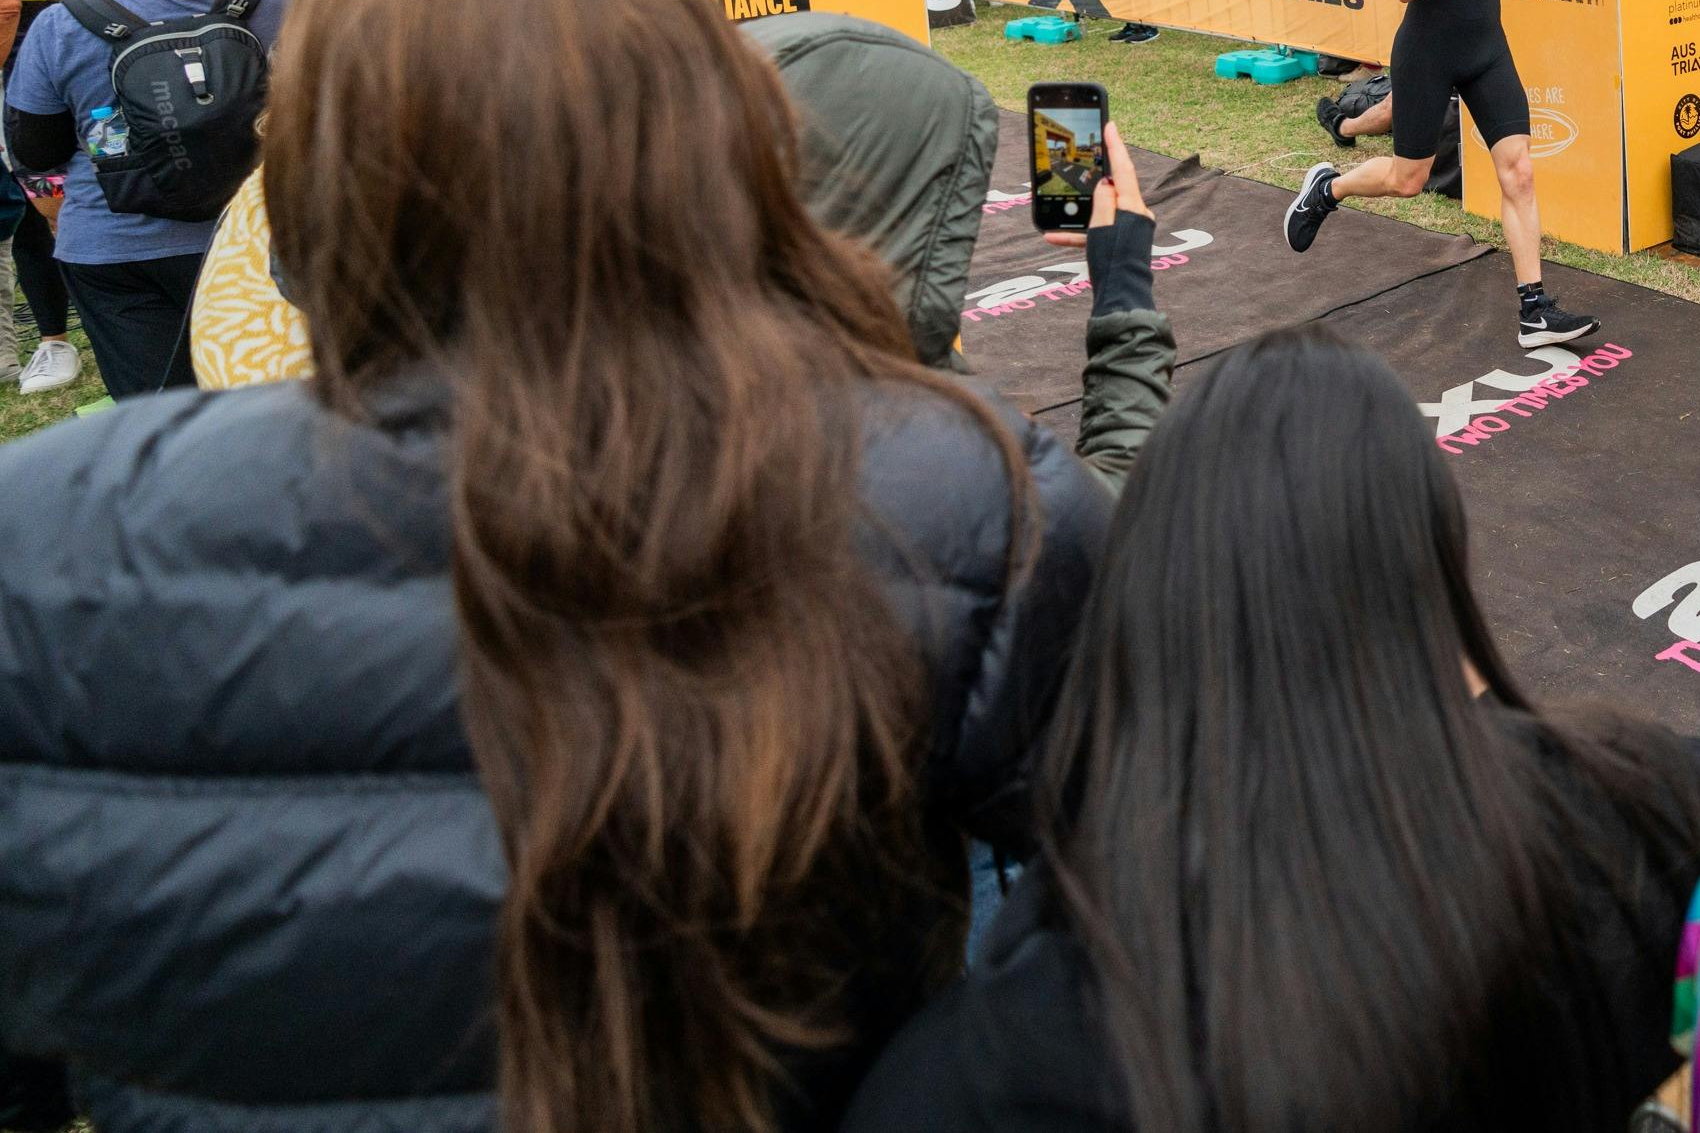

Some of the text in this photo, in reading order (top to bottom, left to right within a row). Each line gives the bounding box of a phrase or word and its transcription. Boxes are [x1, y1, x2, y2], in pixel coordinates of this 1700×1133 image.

[1671, 42, 1696, 61] AUS
[150, 79, 193, 171] macpac
[1545, 86, 1566, 105] ARE
[961, 253, 1191, 322] TWO TIM OU
[1416, 345, 1583, 439] XU
[1435, 342, 1634, 455] TWO TIMES YOU
